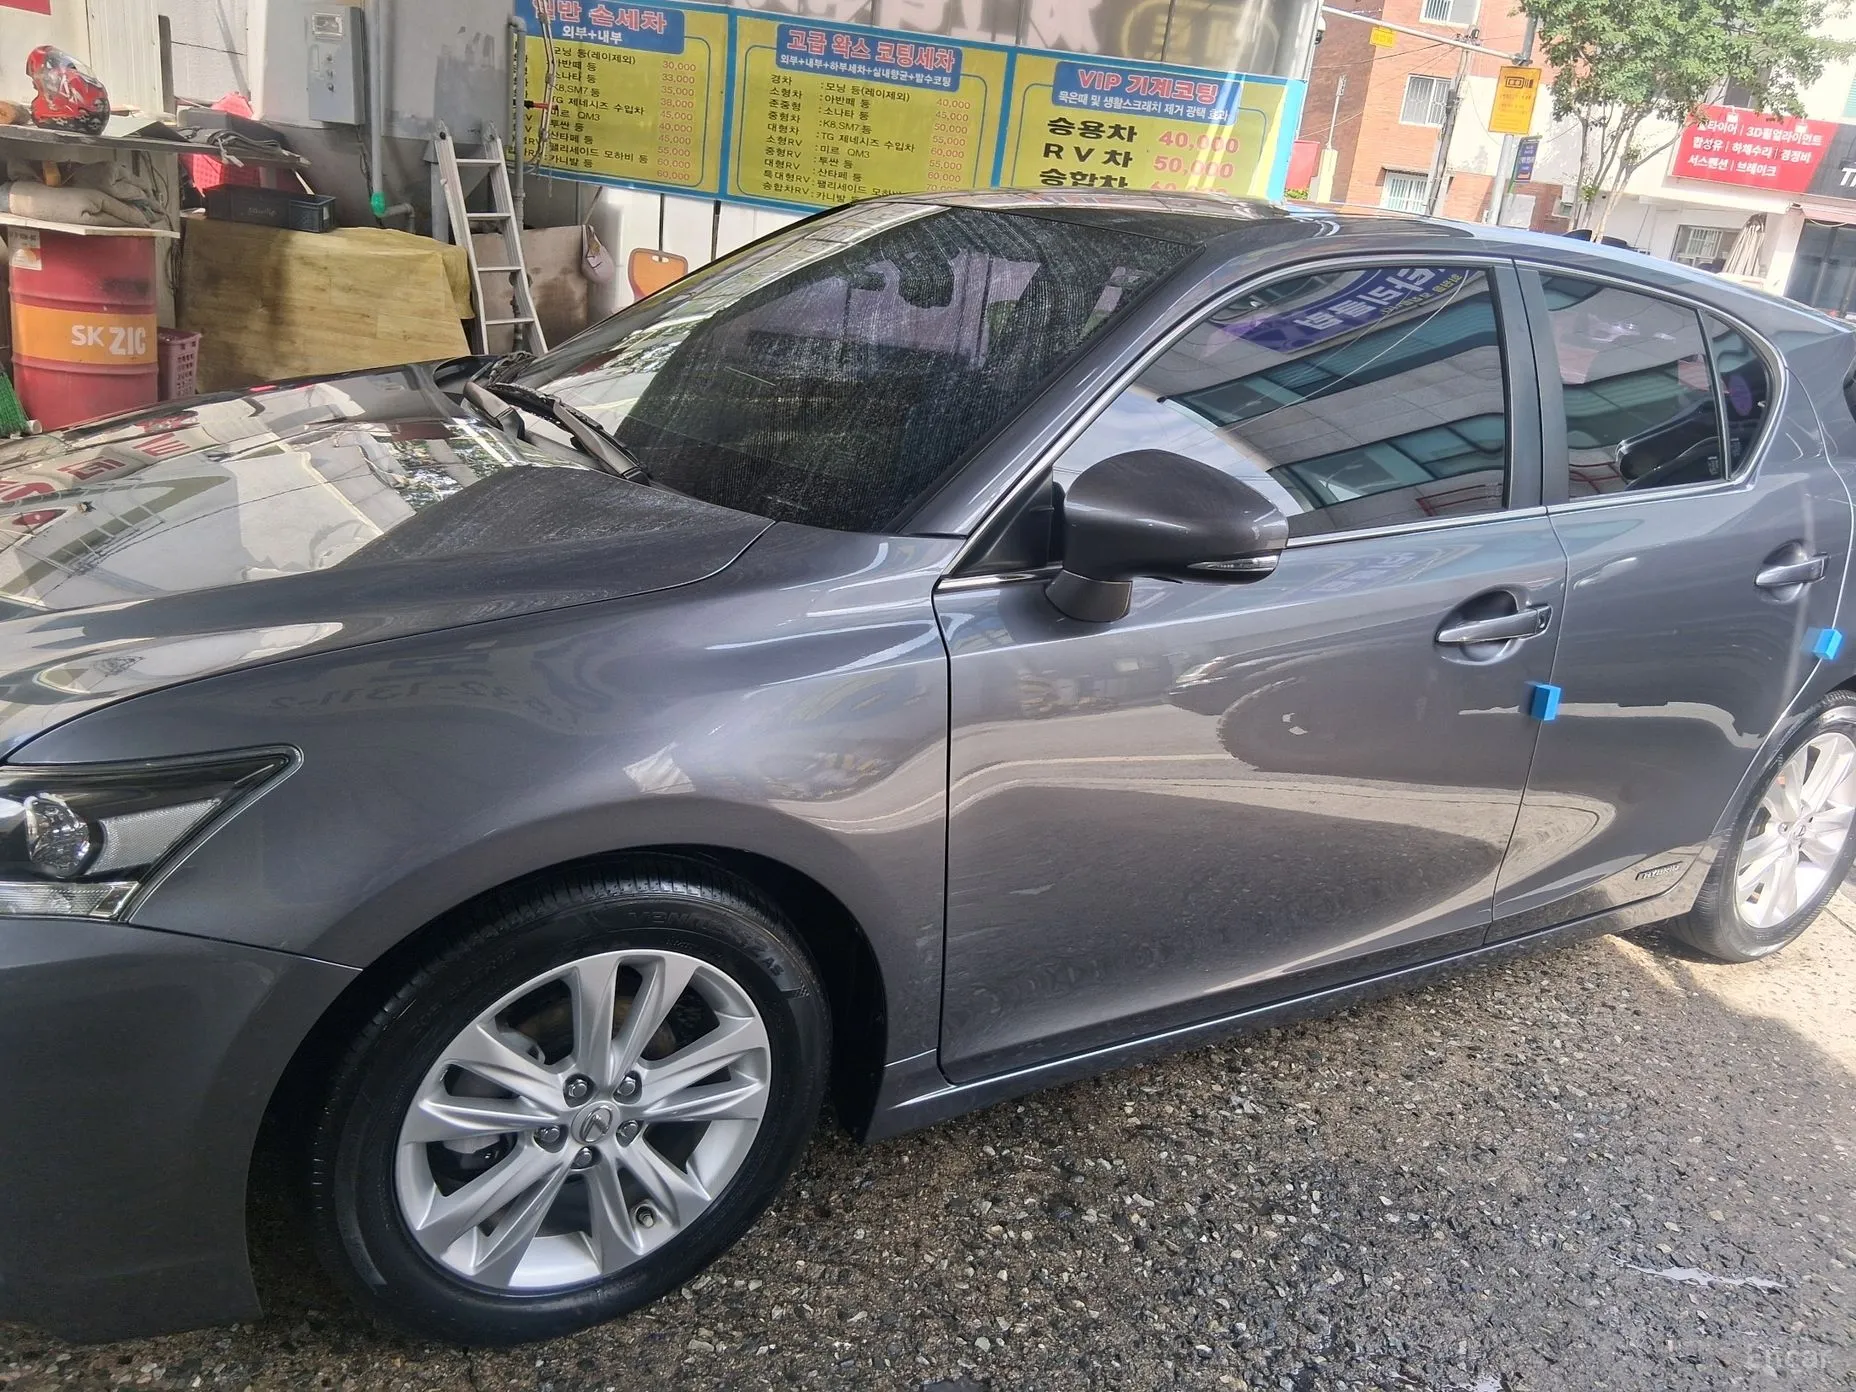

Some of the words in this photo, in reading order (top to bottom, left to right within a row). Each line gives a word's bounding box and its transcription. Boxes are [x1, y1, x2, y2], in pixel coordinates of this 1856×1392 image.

[588, 4, 667, 34] 손세차
[562, 25, 623, 44] 외부+내부
[787, 29, 827, 55] 고급
[831, 33, 871, 60] 왁스
[875, 41, 956, 74] 코팅세차
[661, 73, 695, 84] 33,000
[662, 60, 697, 72] 30,000
[661, 85, 695, 97] 35,000
[770, 74, 792, 86] 경차
[936, 98, 971, 110] 40,000
[1077, 68, 1122, 91] VIP
[1126, 75, 1219, 105] 기계코팅
[613, 103, 645, 116] 수입차
[660, 97, 694, 109] 38,000
[769, 87, 802, 99] 소형차
[935, 111, 969, 122] 45,000
[1058, 90, 1089, 105] 묵은때
[1090, 94, 1102, 107] 및
[1103, 96, 1162, 113] 생활스크래치
[1163, 103, 1184, 117] 제거
[1185, 105, 1207, 119] 광택
[767, 110, 800, 124] 중형차
[932, 135, 966, 147] 55,000
[767, 123, 800, 136] 대형차
[883, 140, 916, 153] 수입차
[930, 147, 965, 159] 60,000
[934, 122, 968, 135] 50,000
[1047, 117, 1138, 143] 승용차
[1158, 130, 1240, 154] 40,000
[764, 158, 801, 171] 대형RV
[765, 135, 803, 147] 소형RV
[847, 148, 871, 159] QM3
[928, 159, 963, 171] 55,000
[765, 146, 802, 159] 중형RV
[927, 171, 962, 183] 60,000
[1039, 168, 1128, 188] 승합차
[1153, 155, 1234, 179] 50,000
[1735, 160, 1777, 177] 브레이크
[762, 181, 810, 195] 승합차RV
[71, 324, 105, 347] SK
[108, 326, 147, 356] ZIC
